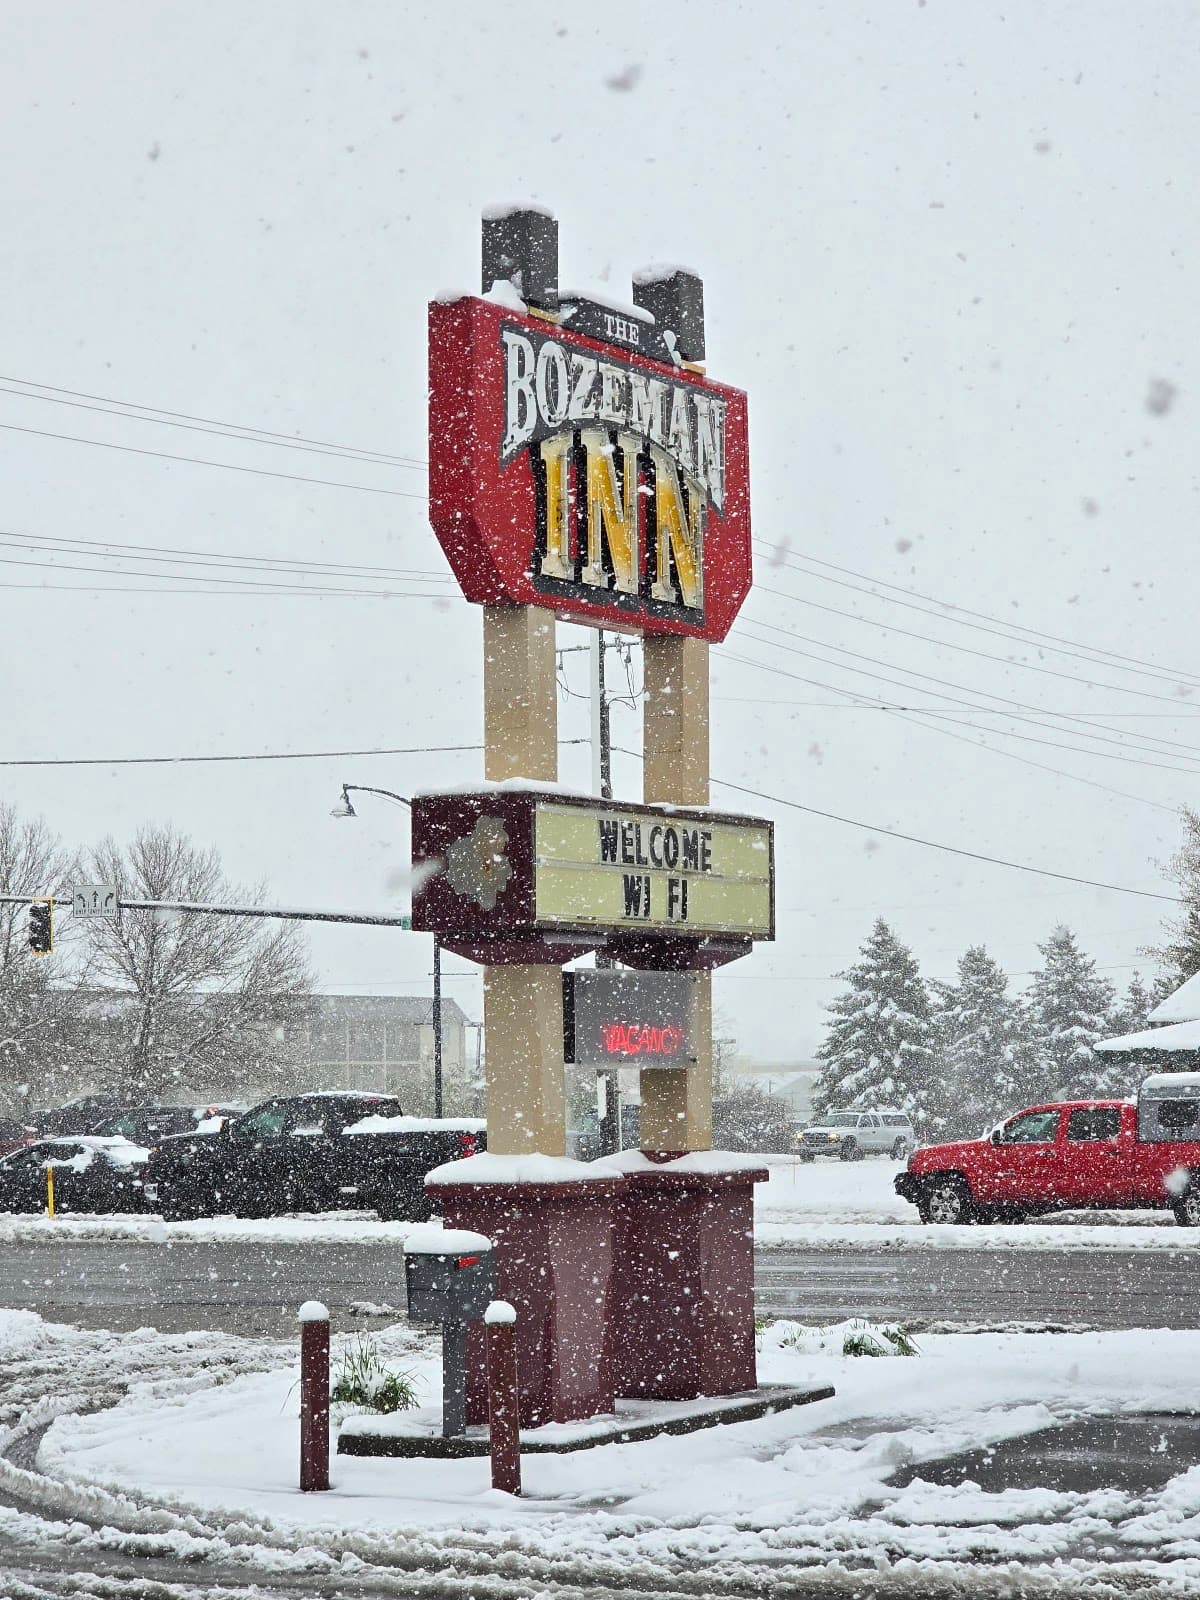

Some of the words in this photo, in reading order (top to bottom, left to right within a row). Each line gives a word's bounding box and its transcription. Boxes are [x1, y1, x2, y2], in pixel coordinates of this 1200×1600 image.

[604, 313, 639, 346] THE
[502, 330, 726, 512] BOZEMAN
[540, 428, 704, 610] INN
[599, 819, 713, 871] WELCOME
[623, 874, 651, 918] WI
[667, 878, 688, 920] FI
